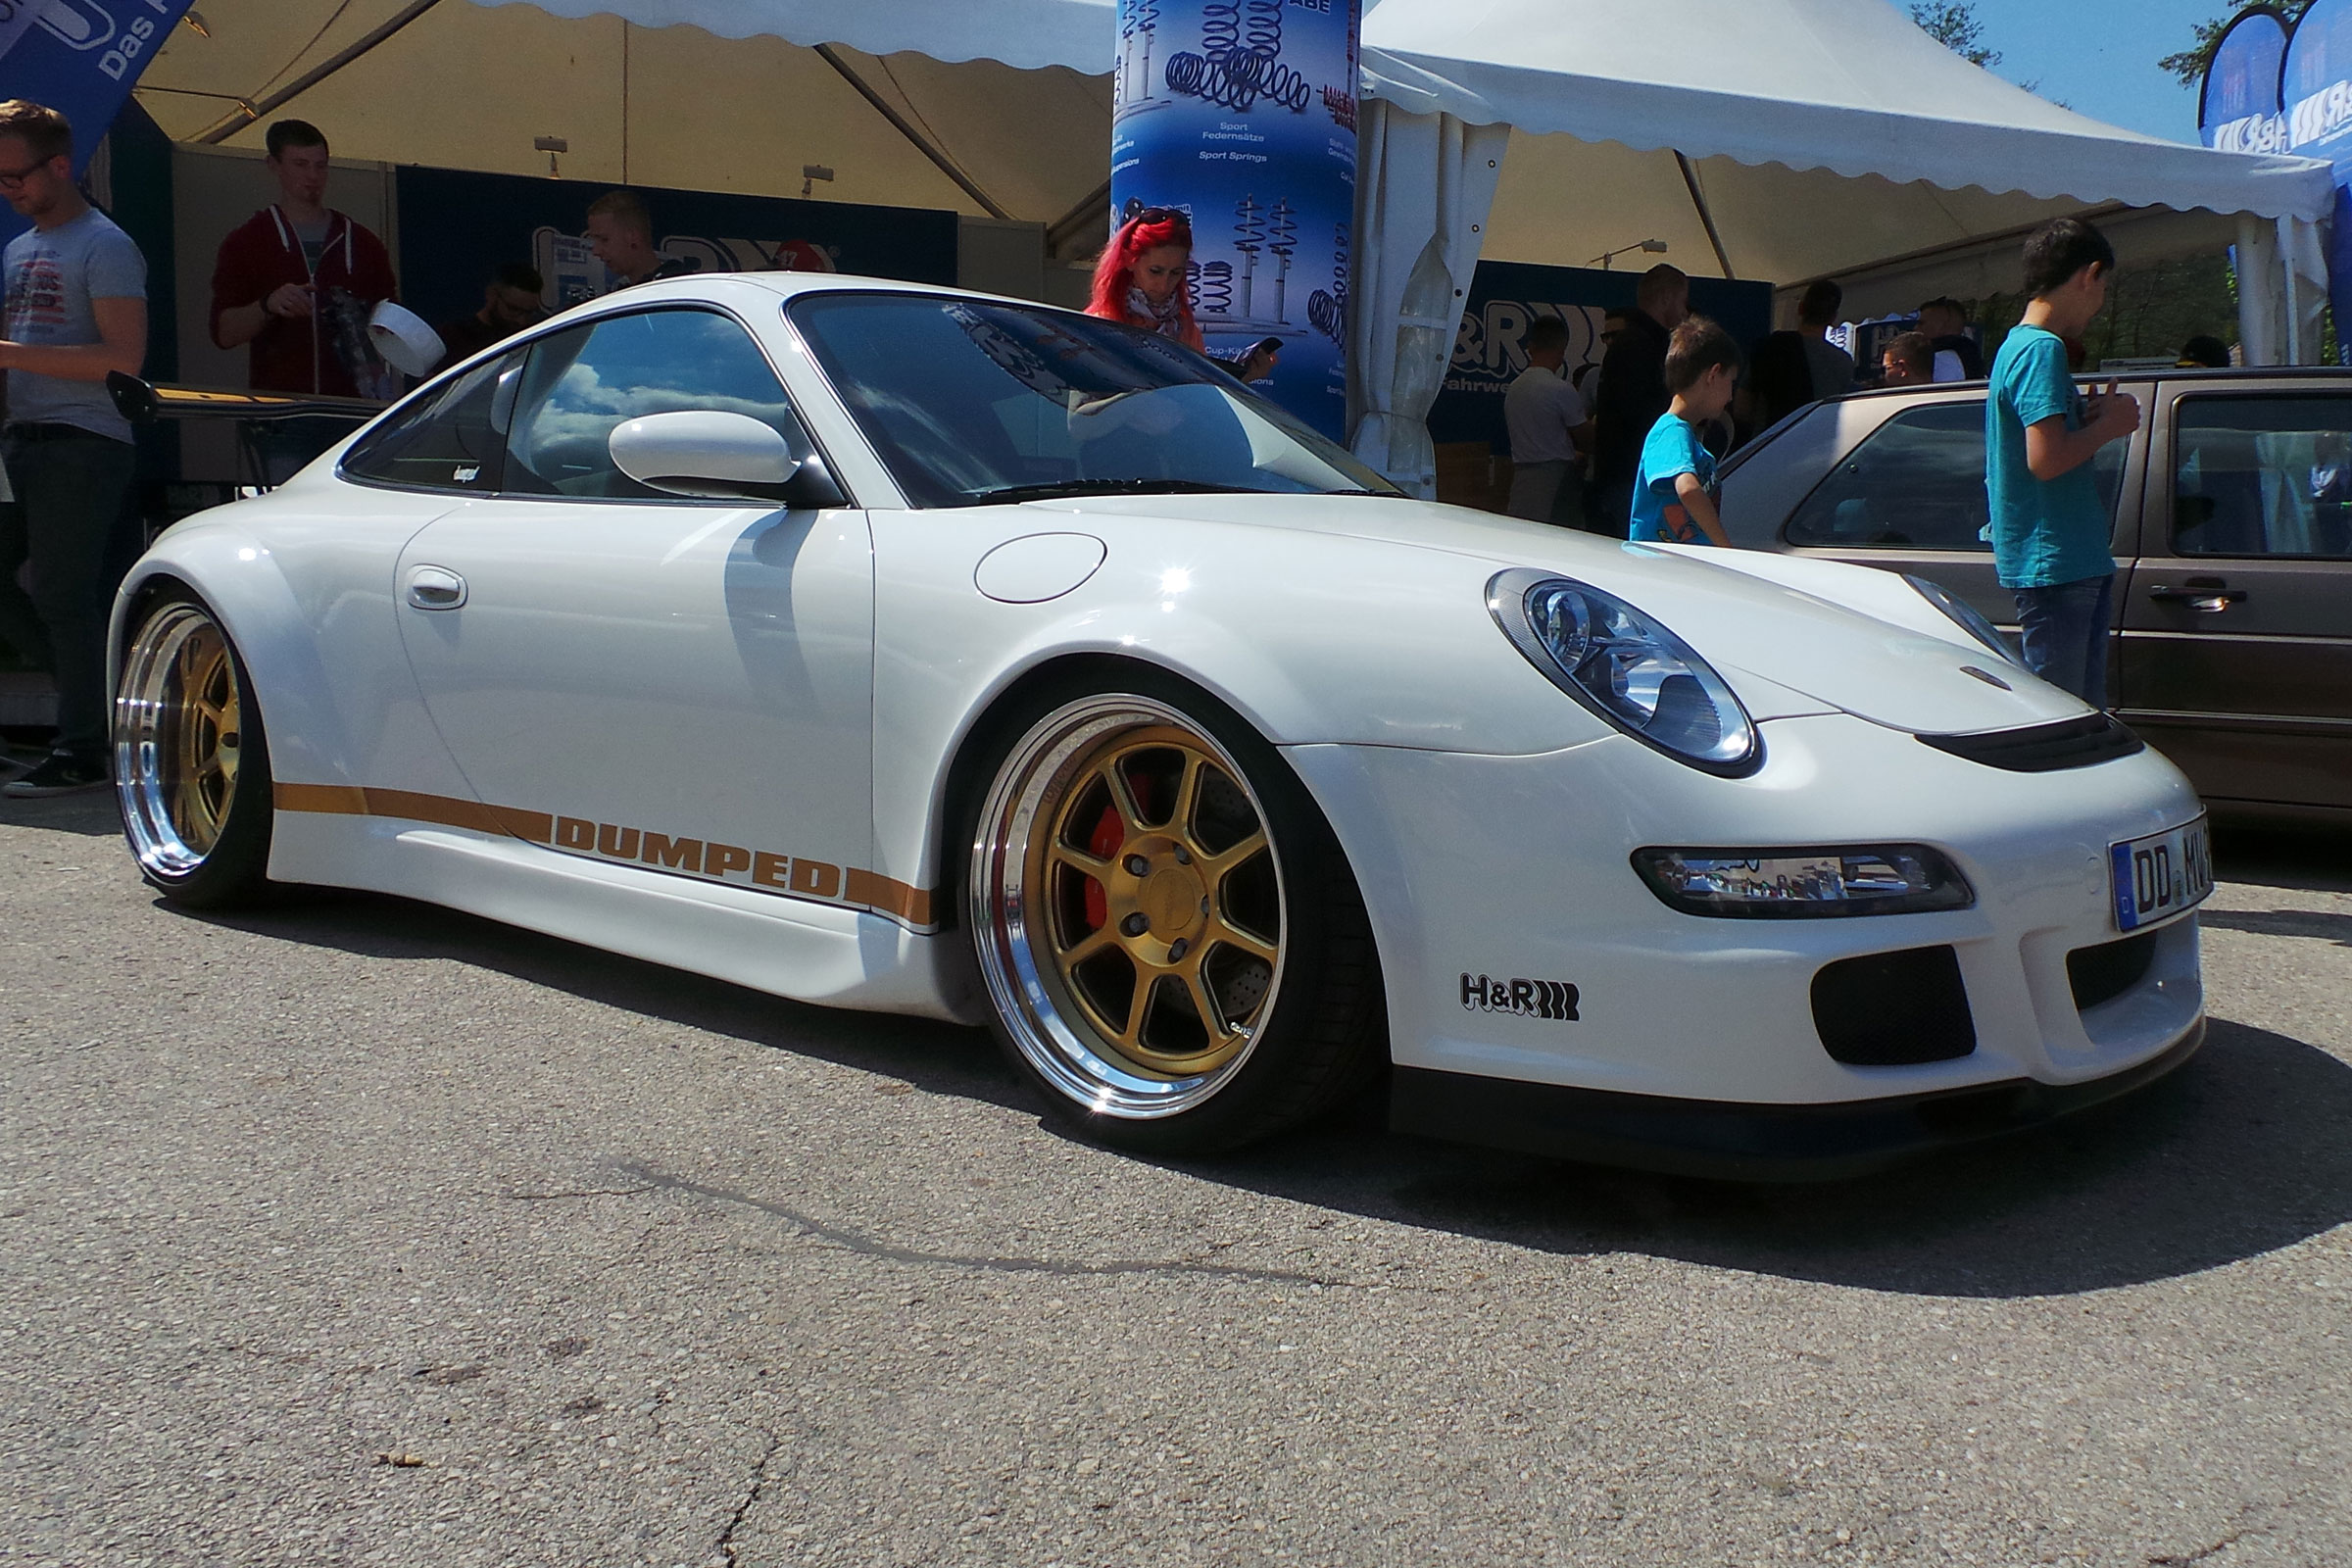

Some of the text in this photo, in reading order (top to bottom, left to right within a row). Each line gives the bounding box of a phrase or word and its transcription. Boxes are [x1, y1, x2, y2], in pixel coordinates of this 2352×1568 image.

[98, 16, 155, 81] Das
[1201, 130, 1265, 142] Federnsätze
[1219, 122, 1249, 131] Sport
[1199, 150, 1268, 164] Sport Springs
[556, 815, 841, 899] DUMPED
[2134, 844, 2172, 914] DD
